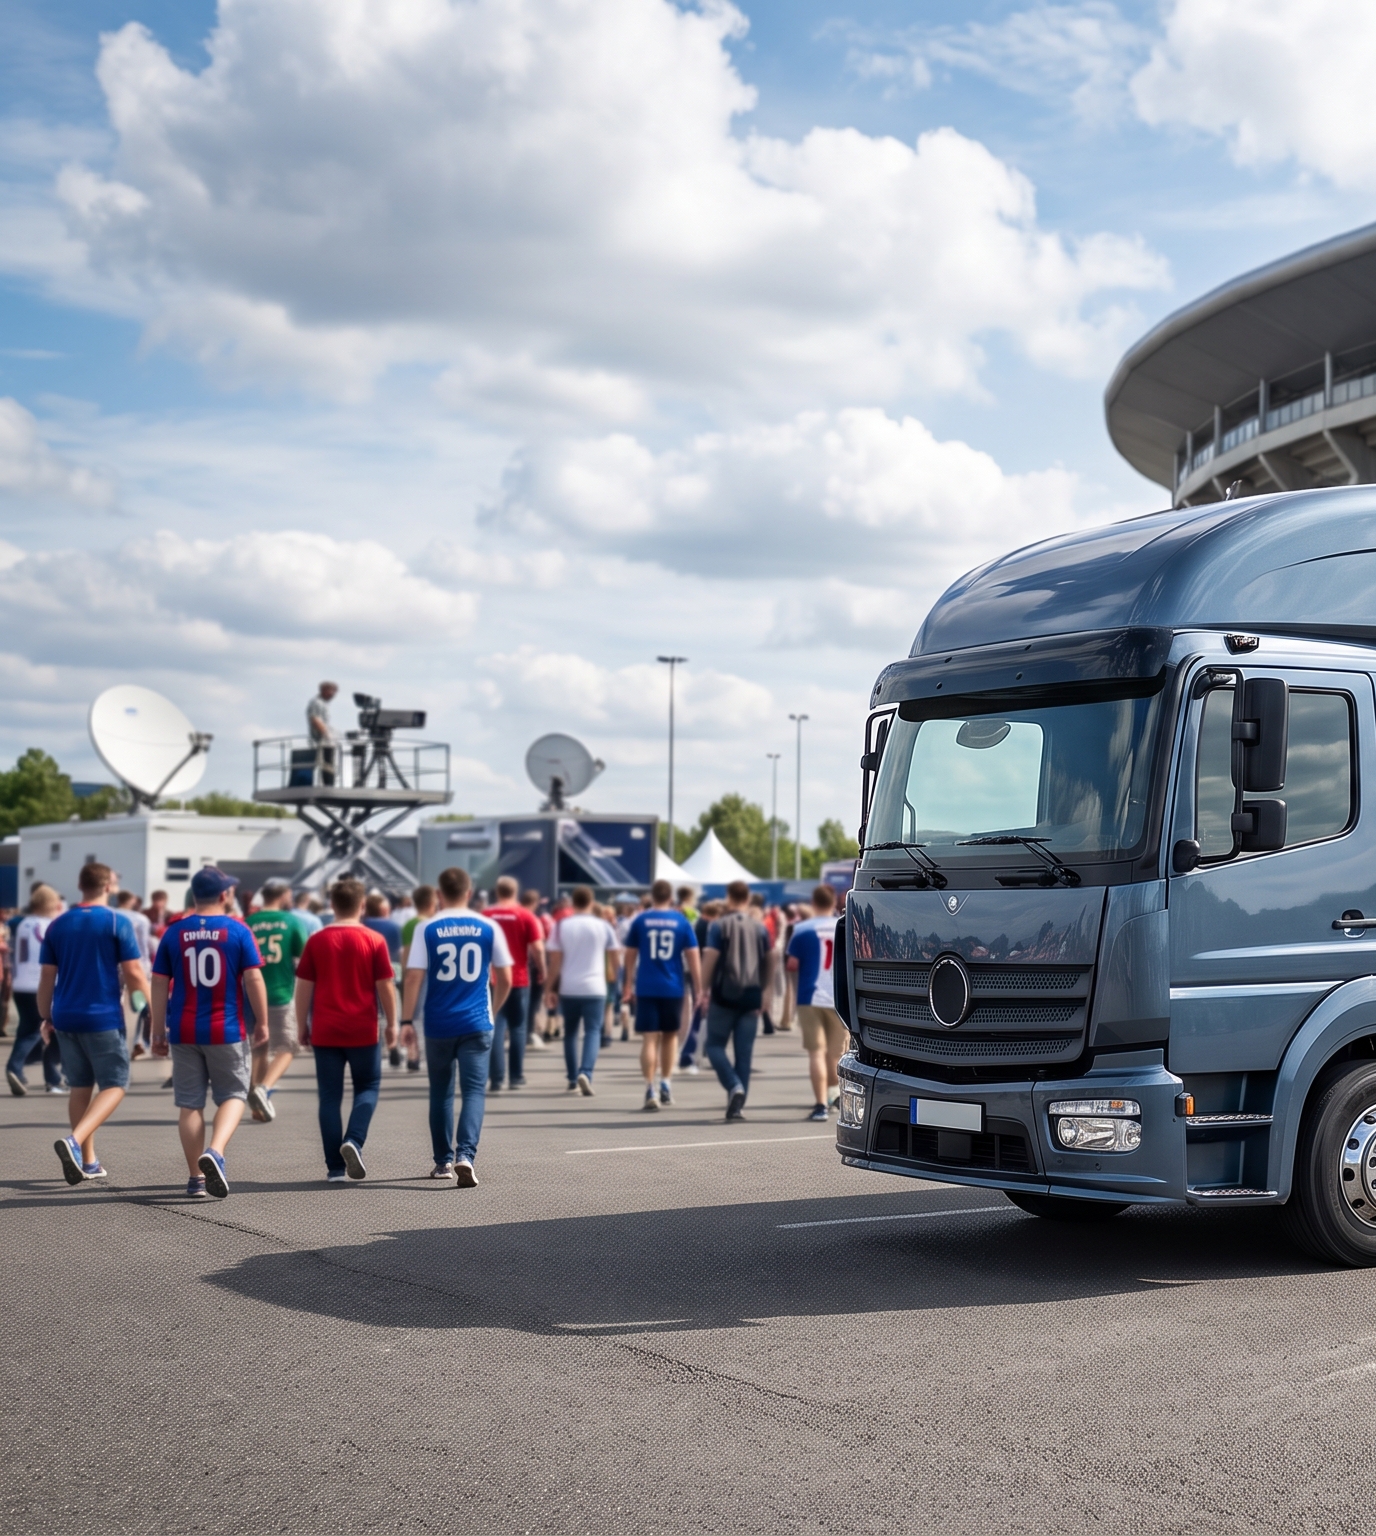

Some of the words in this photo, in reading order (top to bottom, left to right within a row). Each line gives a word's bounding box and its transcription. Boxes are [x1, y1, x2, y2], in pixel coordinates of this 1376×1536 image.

[436, 942, 482, 982] 30
[648, 929, 675, 960] 19
[184, 946, 221, 987] 10
